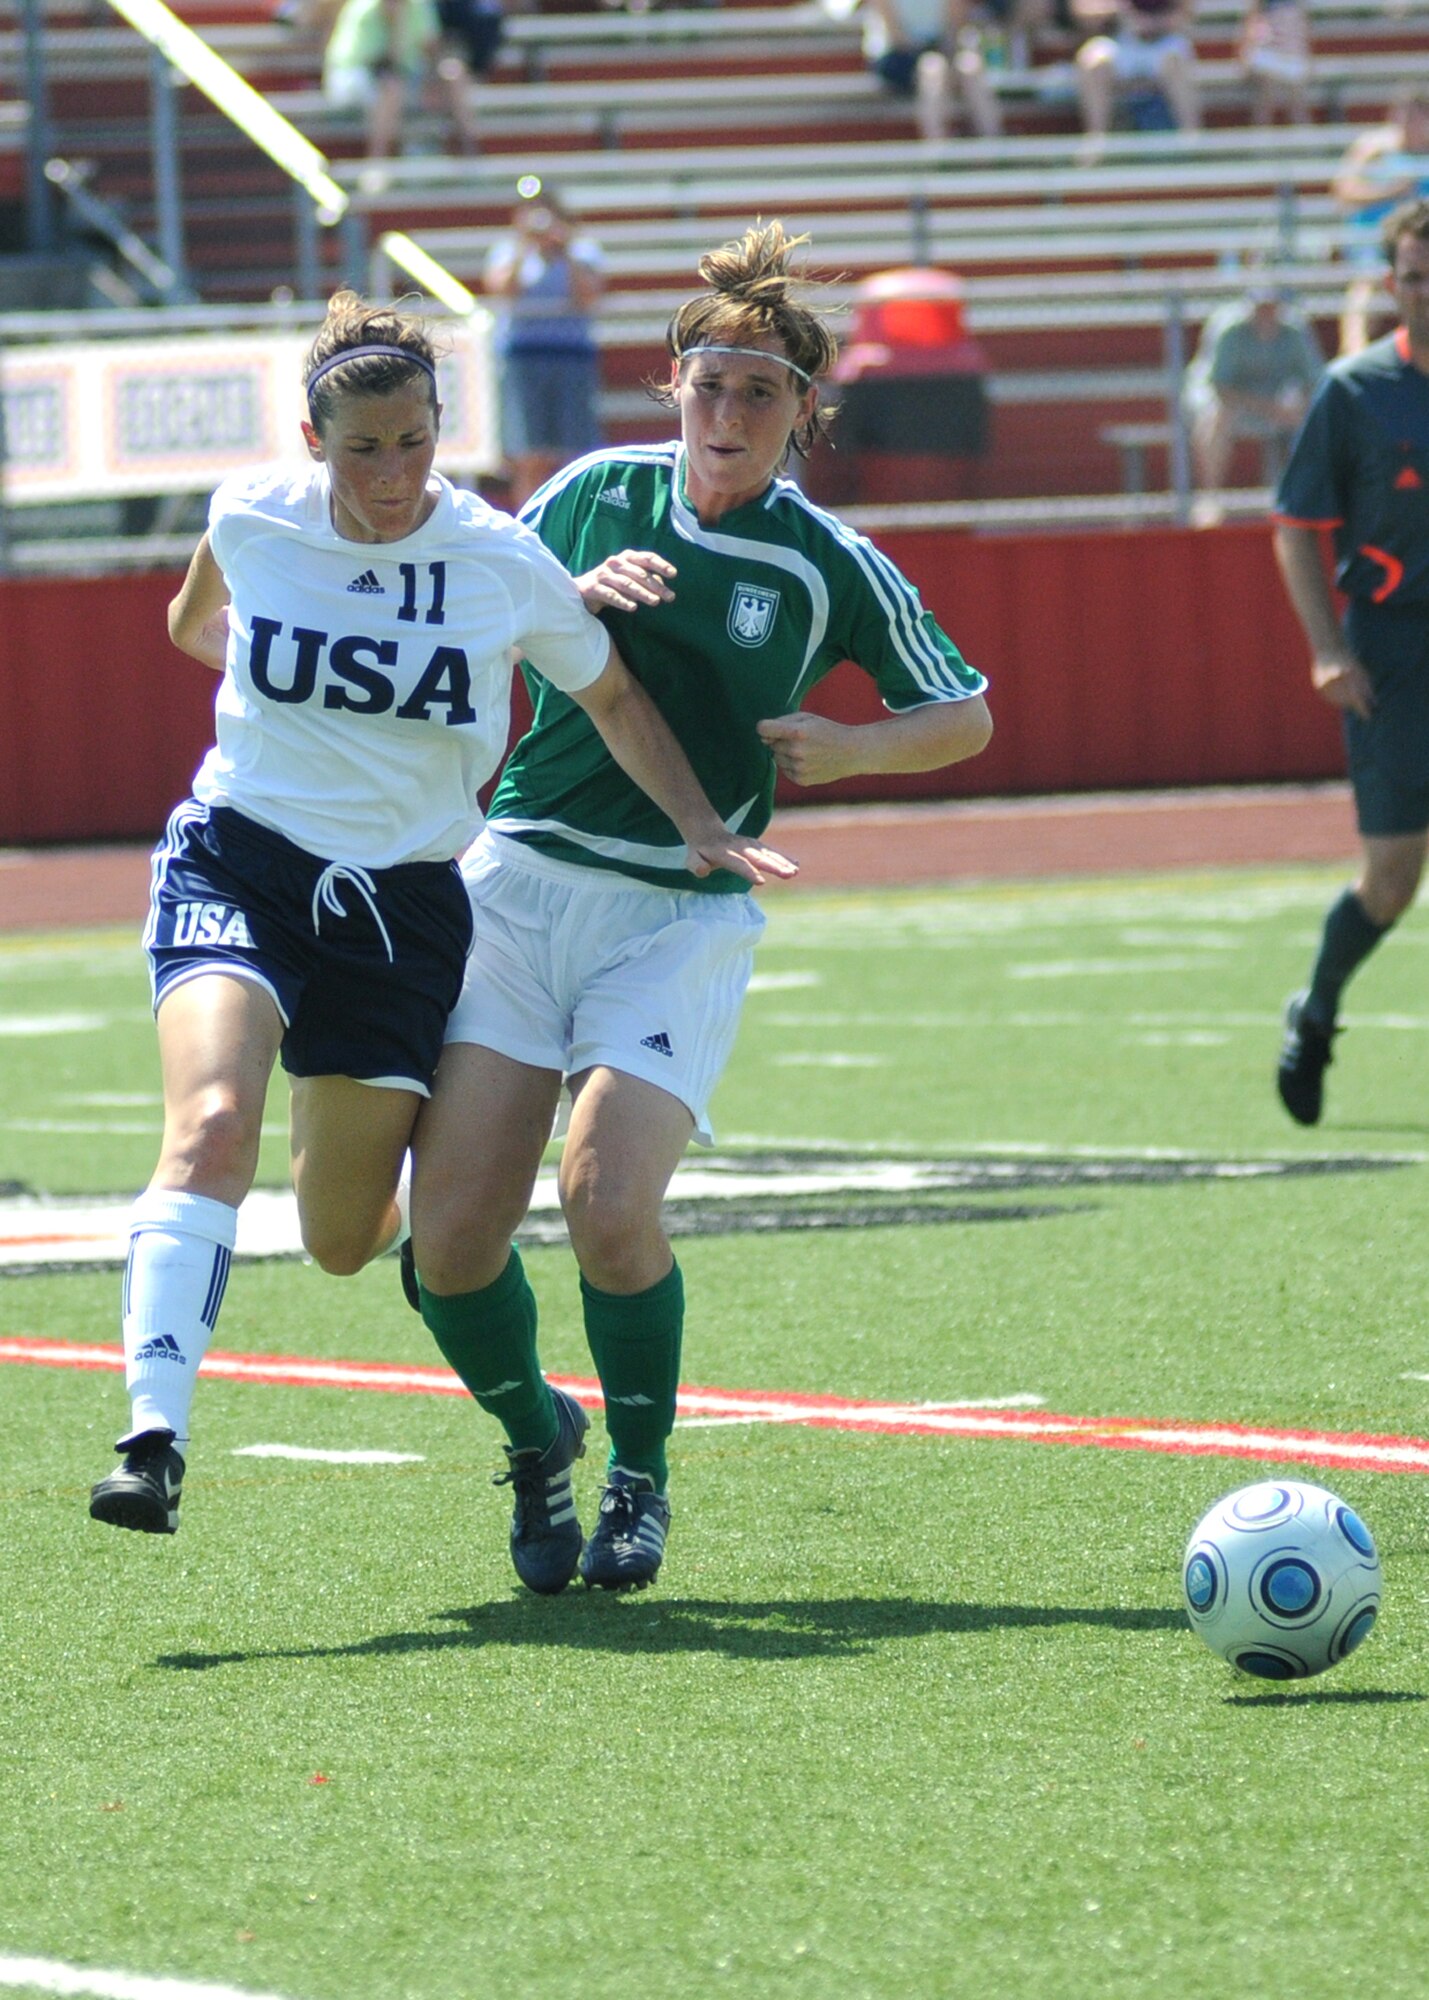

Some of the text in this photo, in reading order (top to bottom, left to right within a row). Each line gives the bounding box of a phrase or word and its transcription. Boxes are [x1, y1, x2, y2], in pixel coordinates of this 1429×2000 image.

[346, 583, 386, 594] adidas
[397, 561, 446, 625] 11
[249, 615, 477, 726] USA
[173, 902, 258, 950] USA
[134, 1345, 187, 1366] adidas
